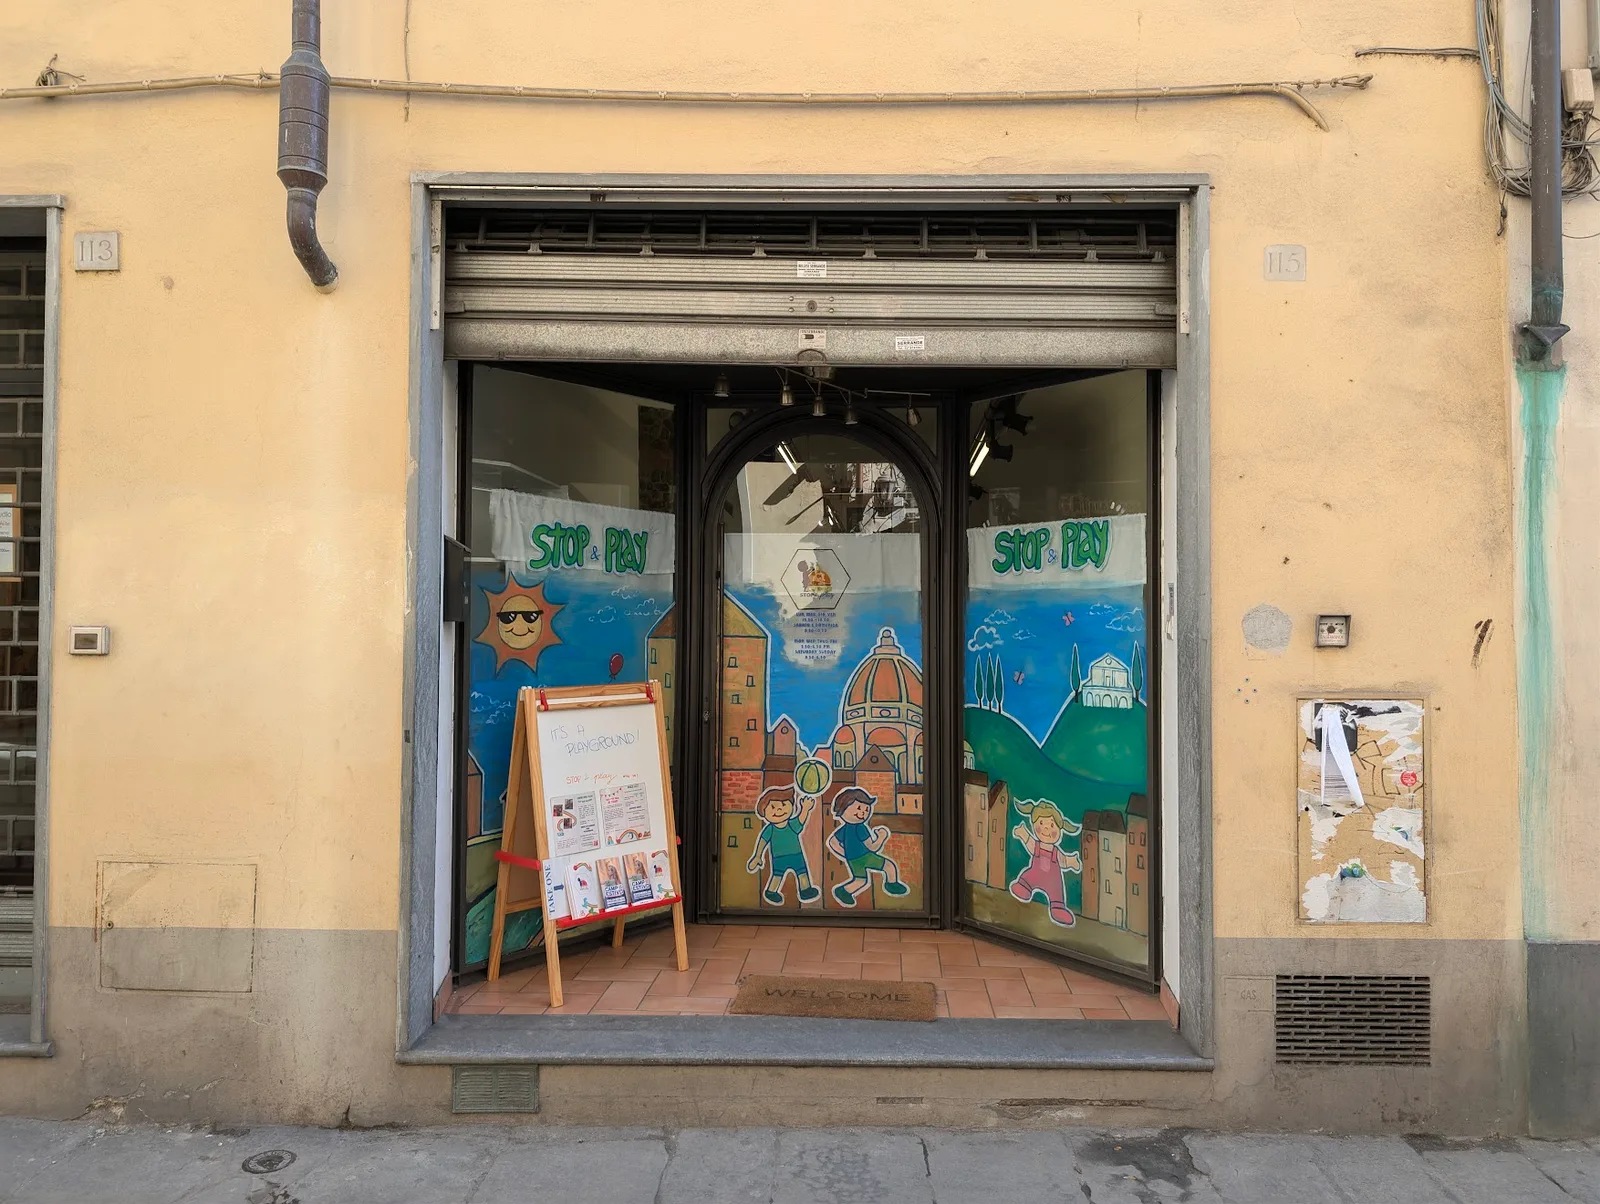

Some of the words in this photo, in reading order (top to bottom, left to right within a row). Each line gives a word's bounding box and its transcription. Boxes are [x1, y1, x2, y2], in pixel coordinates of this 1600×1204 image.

[80, 239, 113, 261] 113
[1267, 251, 1301, 273] 115
[590, 545, 601, 561] &
[1047, 548, 1057, 564] &
[550, 724, 569, 742] IT'S
[576, 724, 585, 736] A
[564, 729, 640, 757] PLAYGROUND!
[544, 864, 552, 886] ONE
[547, 887, 556, 916] TAKE
[763, 988, 911, 1001] WELCOME
